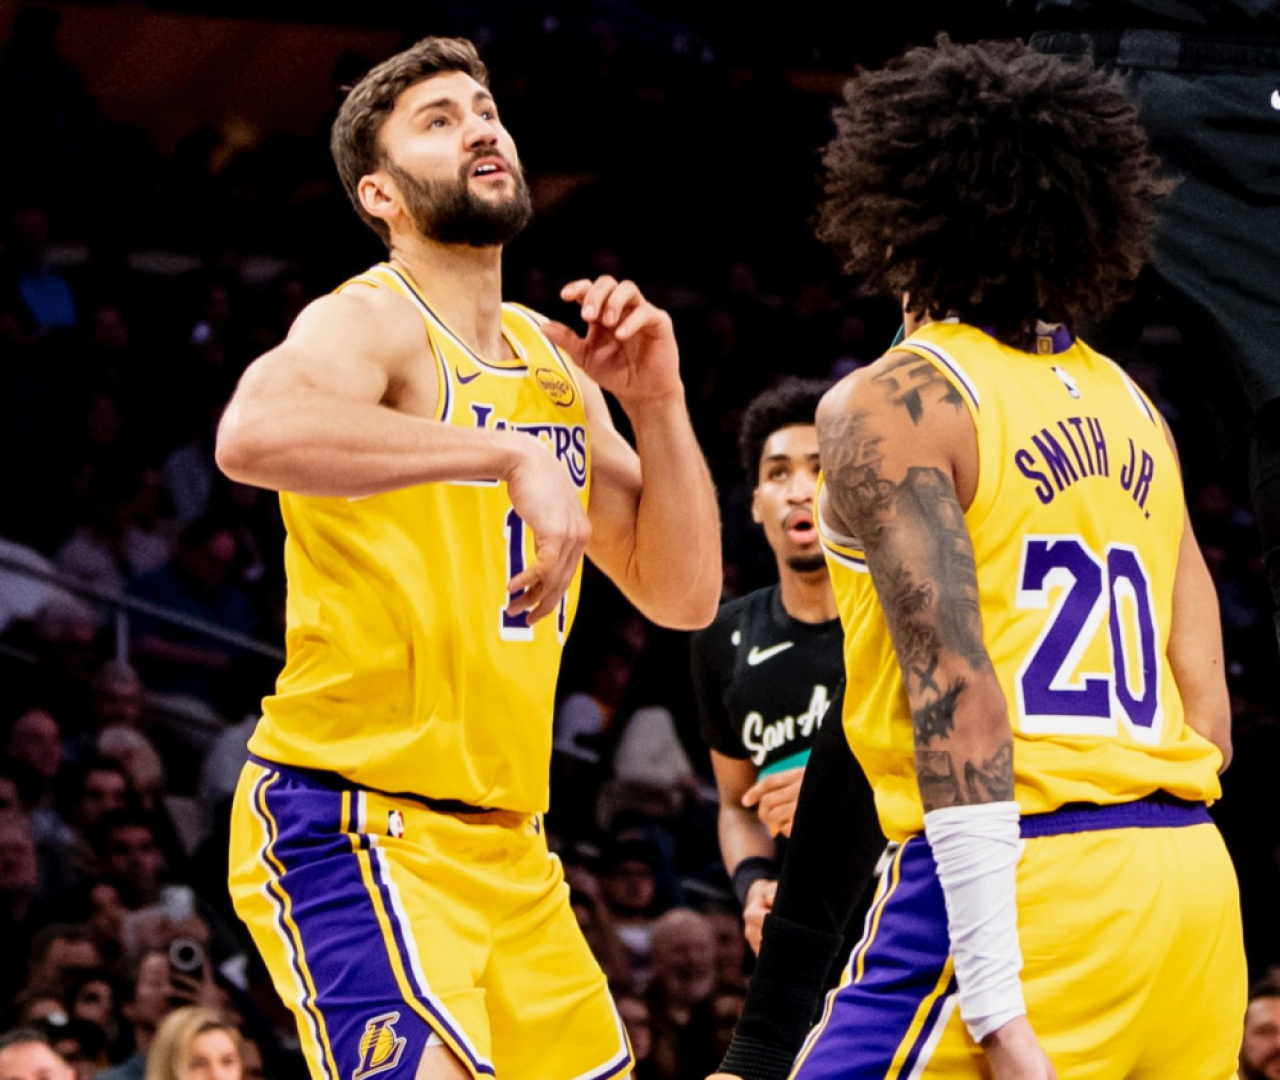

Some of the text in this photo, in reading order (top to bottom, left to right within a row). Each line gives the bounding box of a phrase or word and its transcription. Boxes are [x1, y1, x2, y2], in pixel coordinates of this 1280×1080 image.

[1015, 416, 1155, 520] SMITH JR.
[1015, 534, 1164, 746] 20
[742, 711, 796, 767] San
